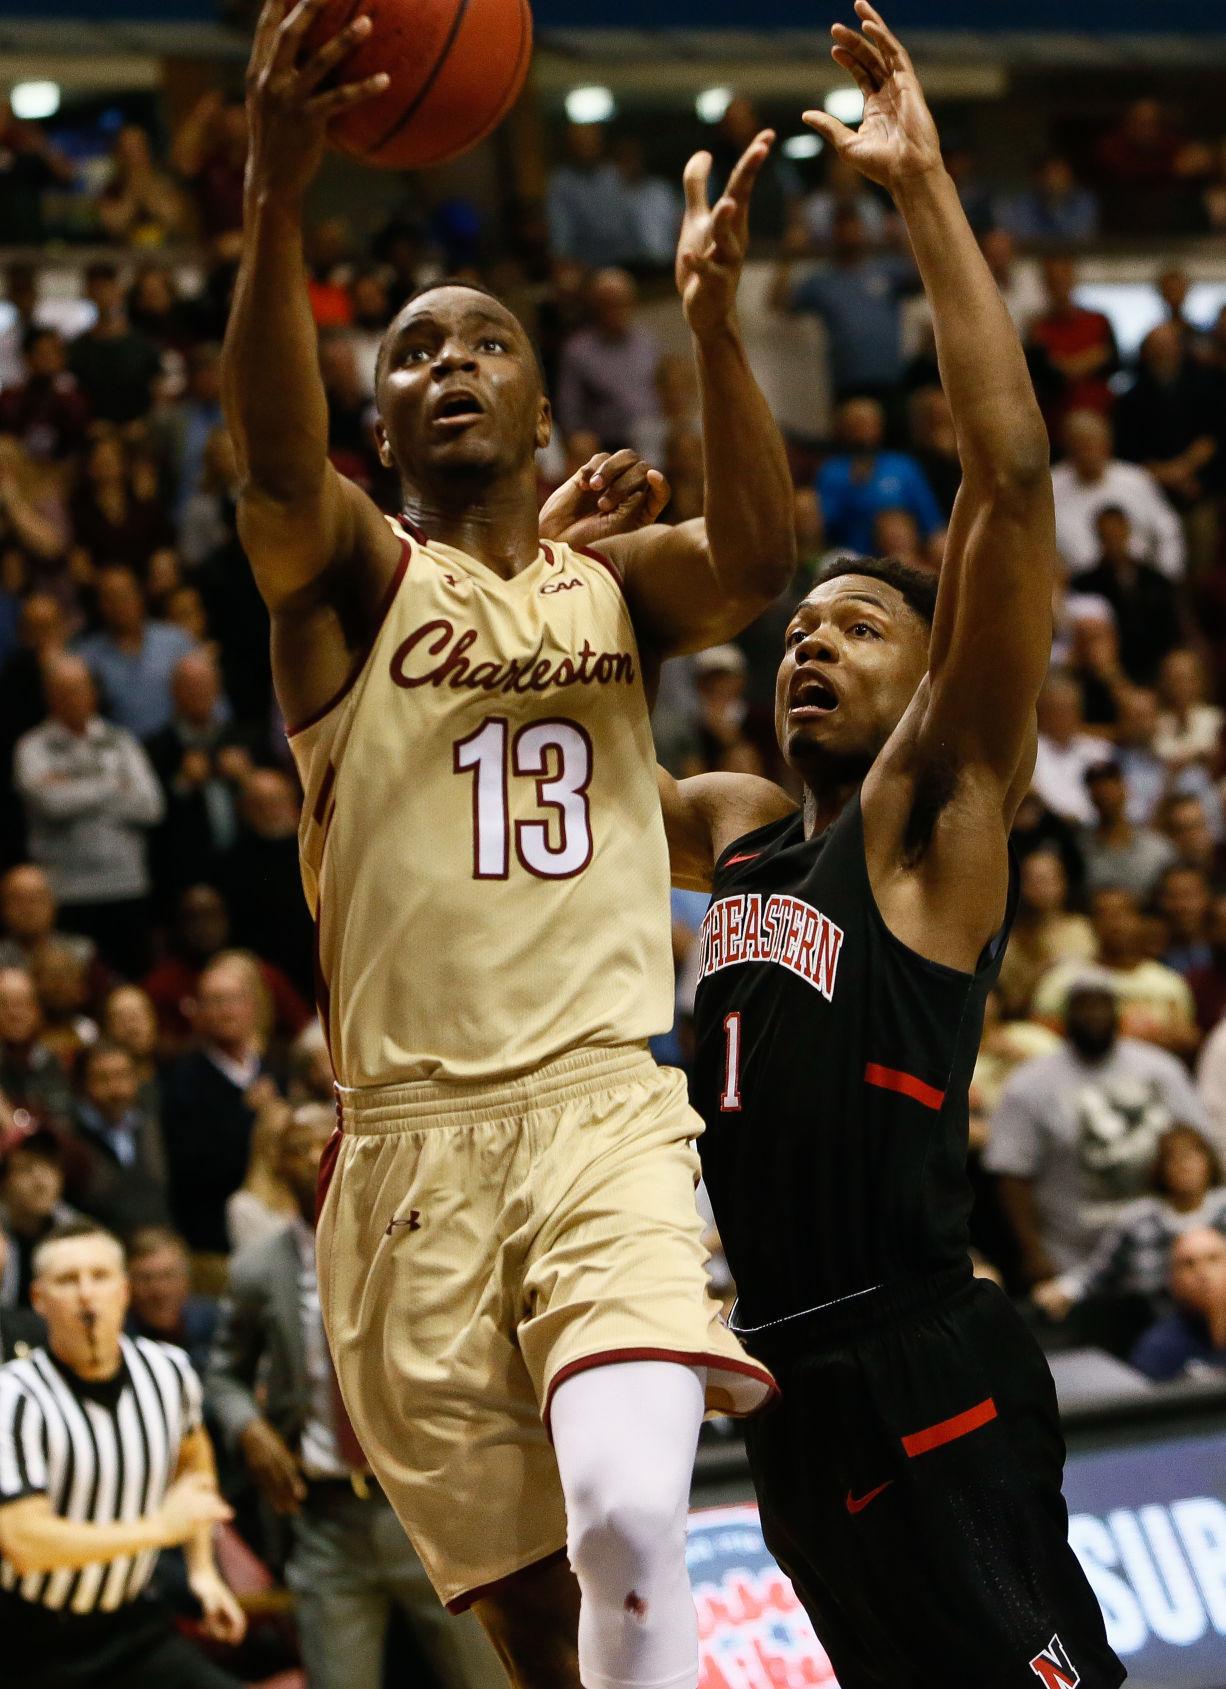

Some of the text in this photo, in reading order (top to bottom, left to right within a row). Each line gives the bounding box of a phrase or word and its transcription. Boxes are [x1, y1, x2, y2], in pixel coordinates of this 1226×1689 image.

[540, 579, 583, 594] CAA
[389, 619, 635, 693] Charleston
[453, 716, 594, 880] 13
[720, 1011, 741, 1112] 1
